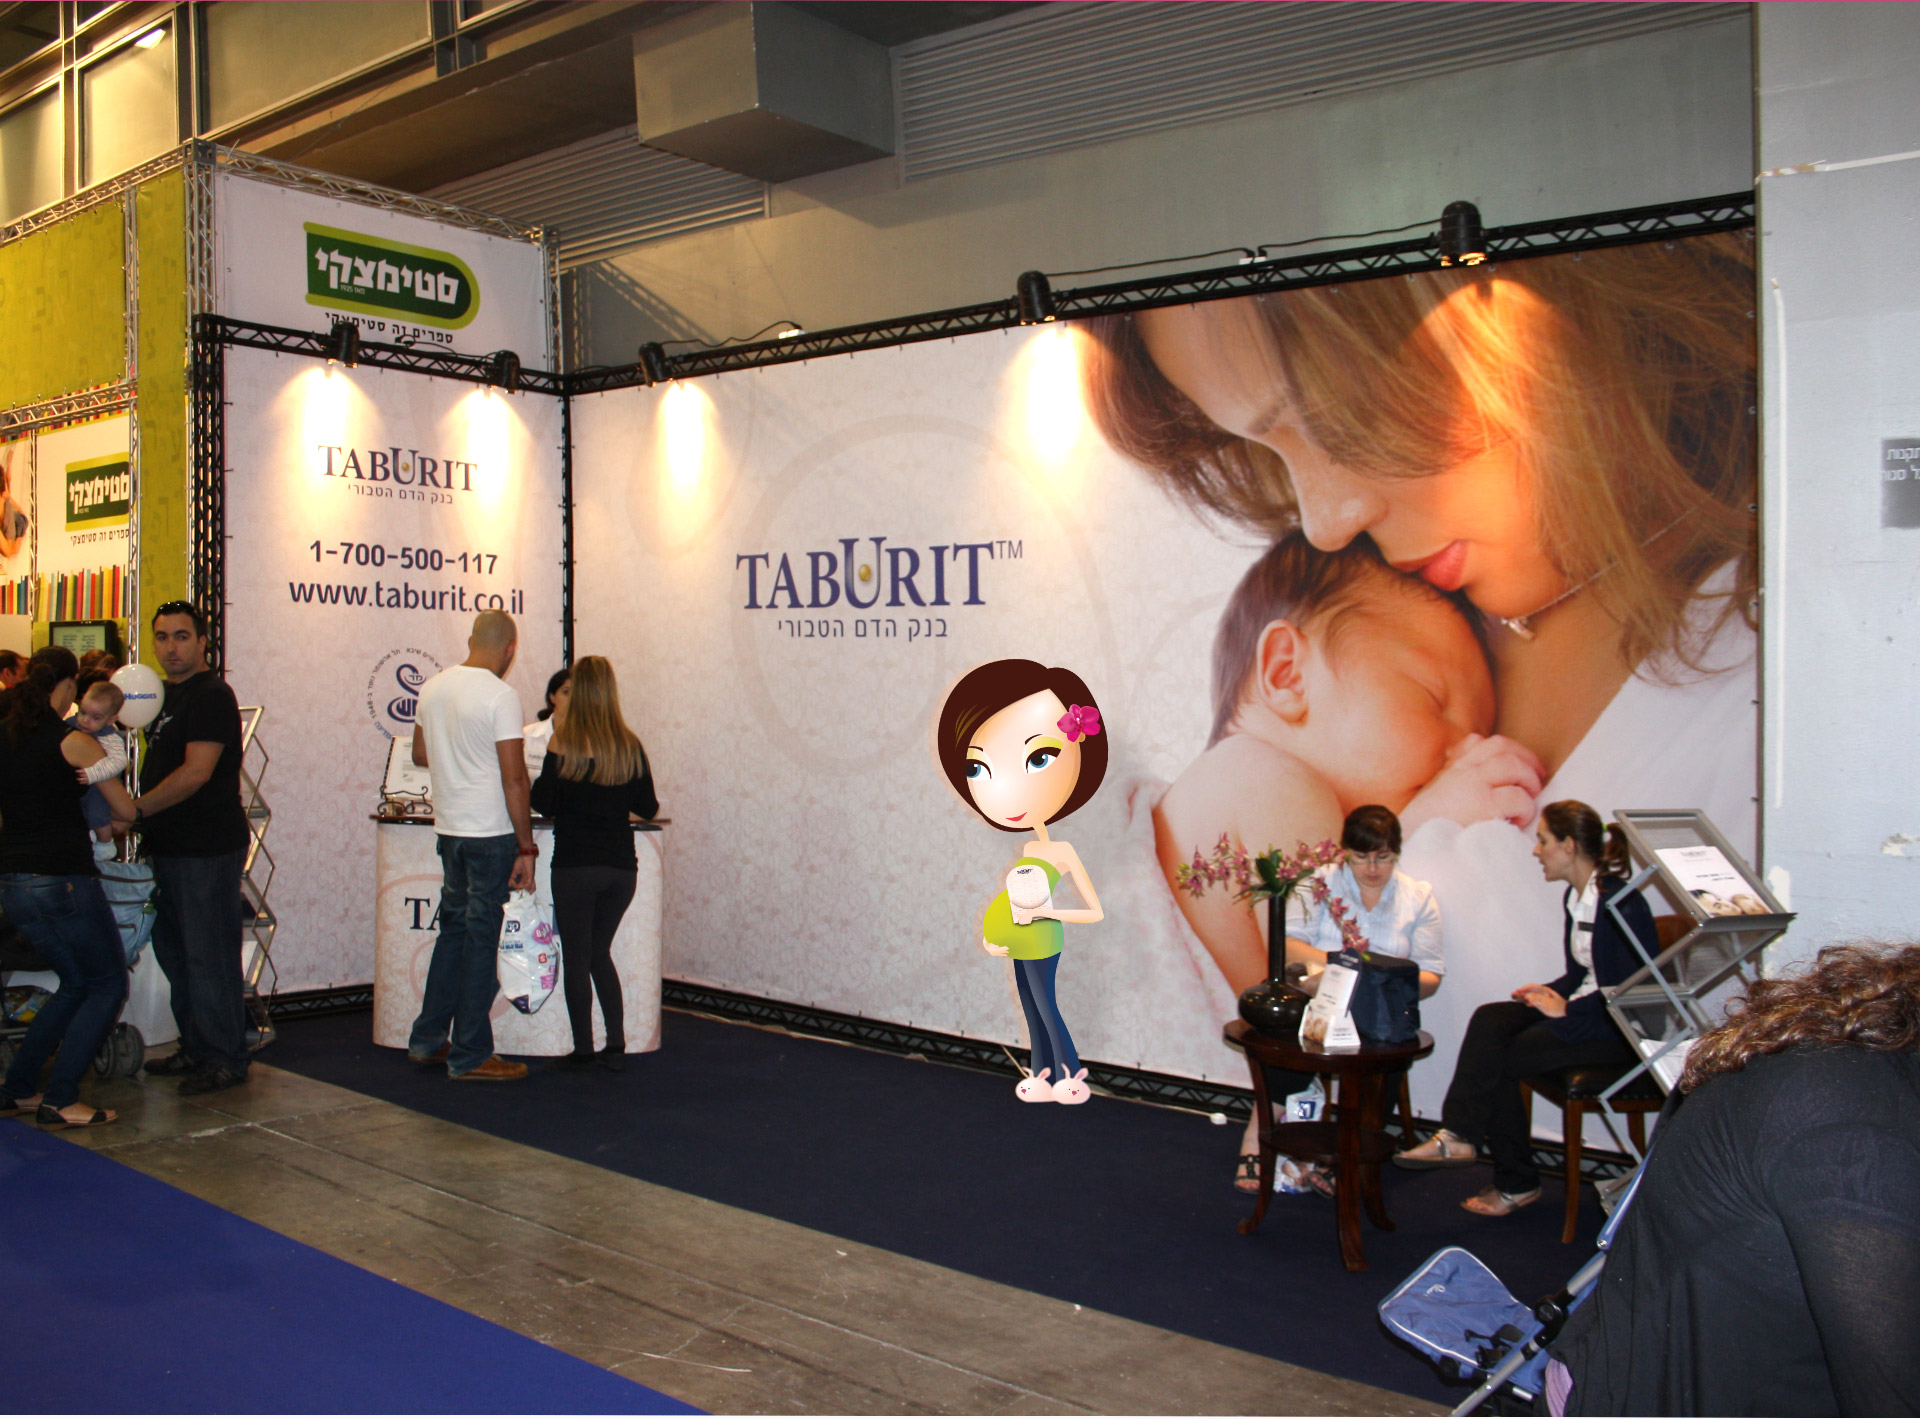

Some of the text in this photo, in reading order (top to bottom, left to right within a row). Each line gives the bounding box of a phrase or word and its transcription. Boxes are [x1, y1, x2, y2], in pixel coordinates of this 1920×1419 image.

[315, 247, 459, 305] סטימצקי
[392, 324, 406, 336] זה
[413, 328, 453, 344] ספרים
[318, 445, 477, 491] TABURIT
[69, 471, 130, 514] סטימצקי
[348, 484, 453, 504] בנק הדם הטבורי
[310, 540, 498, 574] 1-700-500-117
[736, 536, 995, 609] TABURIT
[289, 580, 524, 615] www.taburit.co.il
[778, 618, 948, 642] בנק הדם הטבורי
